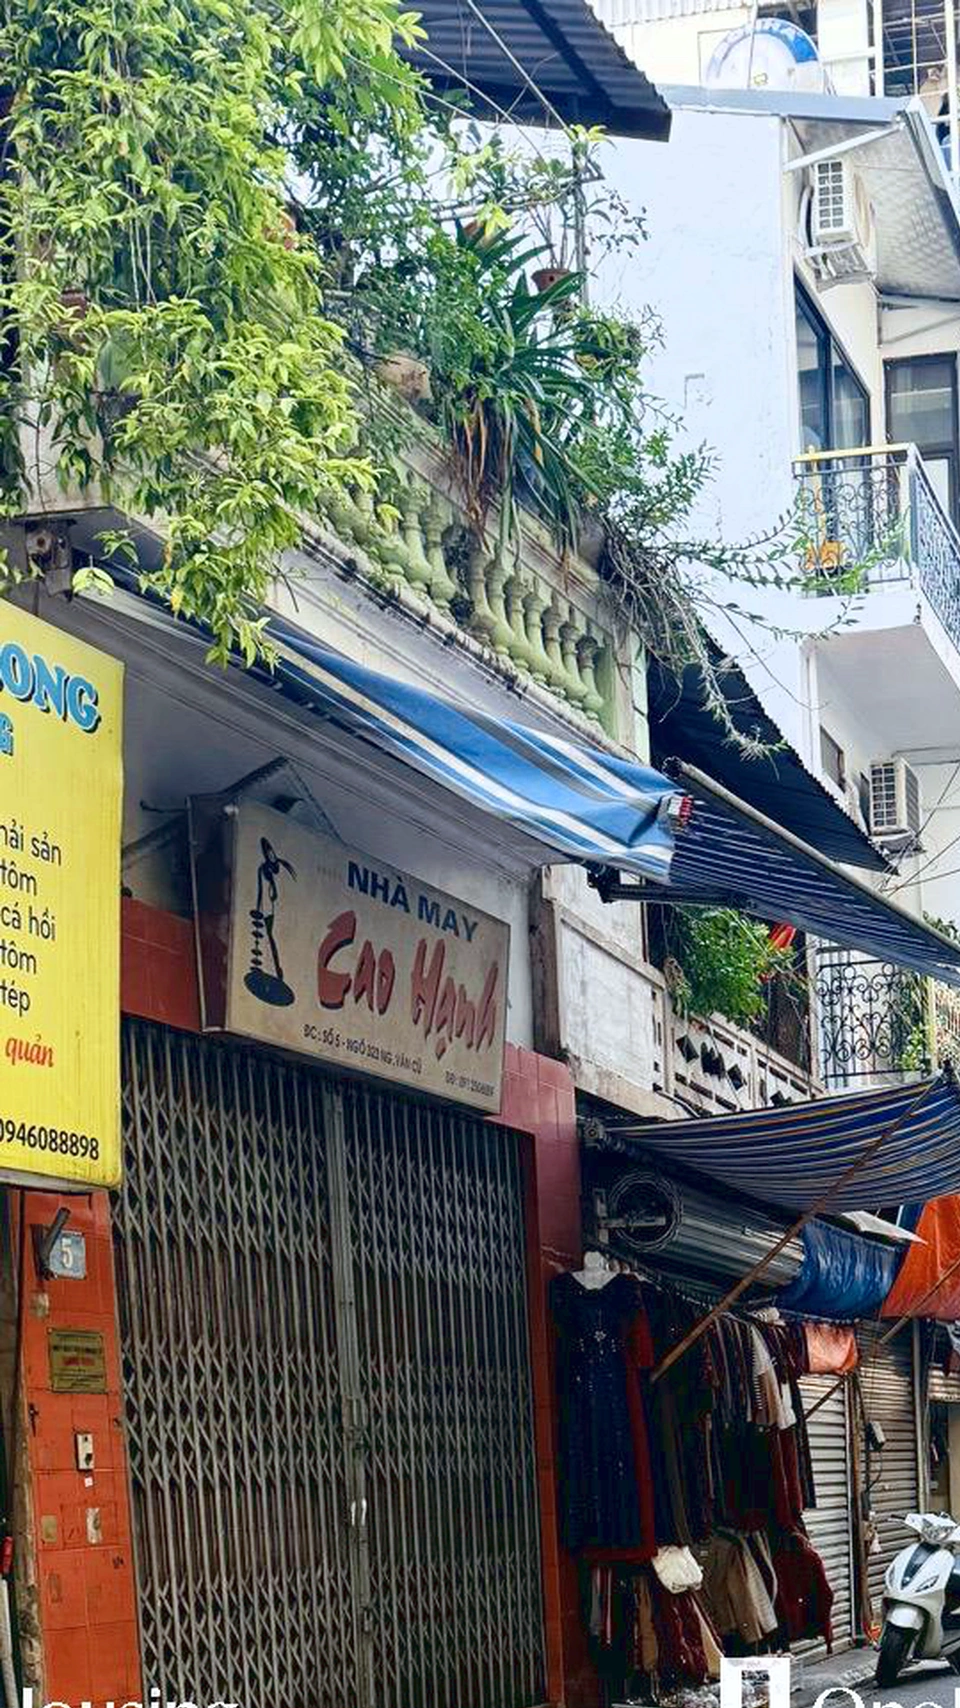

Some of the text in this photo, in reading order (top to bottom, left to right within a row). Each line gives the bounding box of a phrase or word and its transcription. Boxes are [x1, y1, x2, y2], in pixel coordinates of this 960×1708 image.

[31, 832, 61, 866] sản
[0, 858, 37, 896] tôm
[347, 860, 478, 943] NHÀ MAY
[1, 902, 56, 942] cá hồi
[0, 939, 37, 975] tôm
[0, 977, 31, 1017] tép
[317, 910, 498, 1061] Cao Hạnh
[6, 1034, 54, 1068] quản
[61, 1237, 74, 1269] 5
